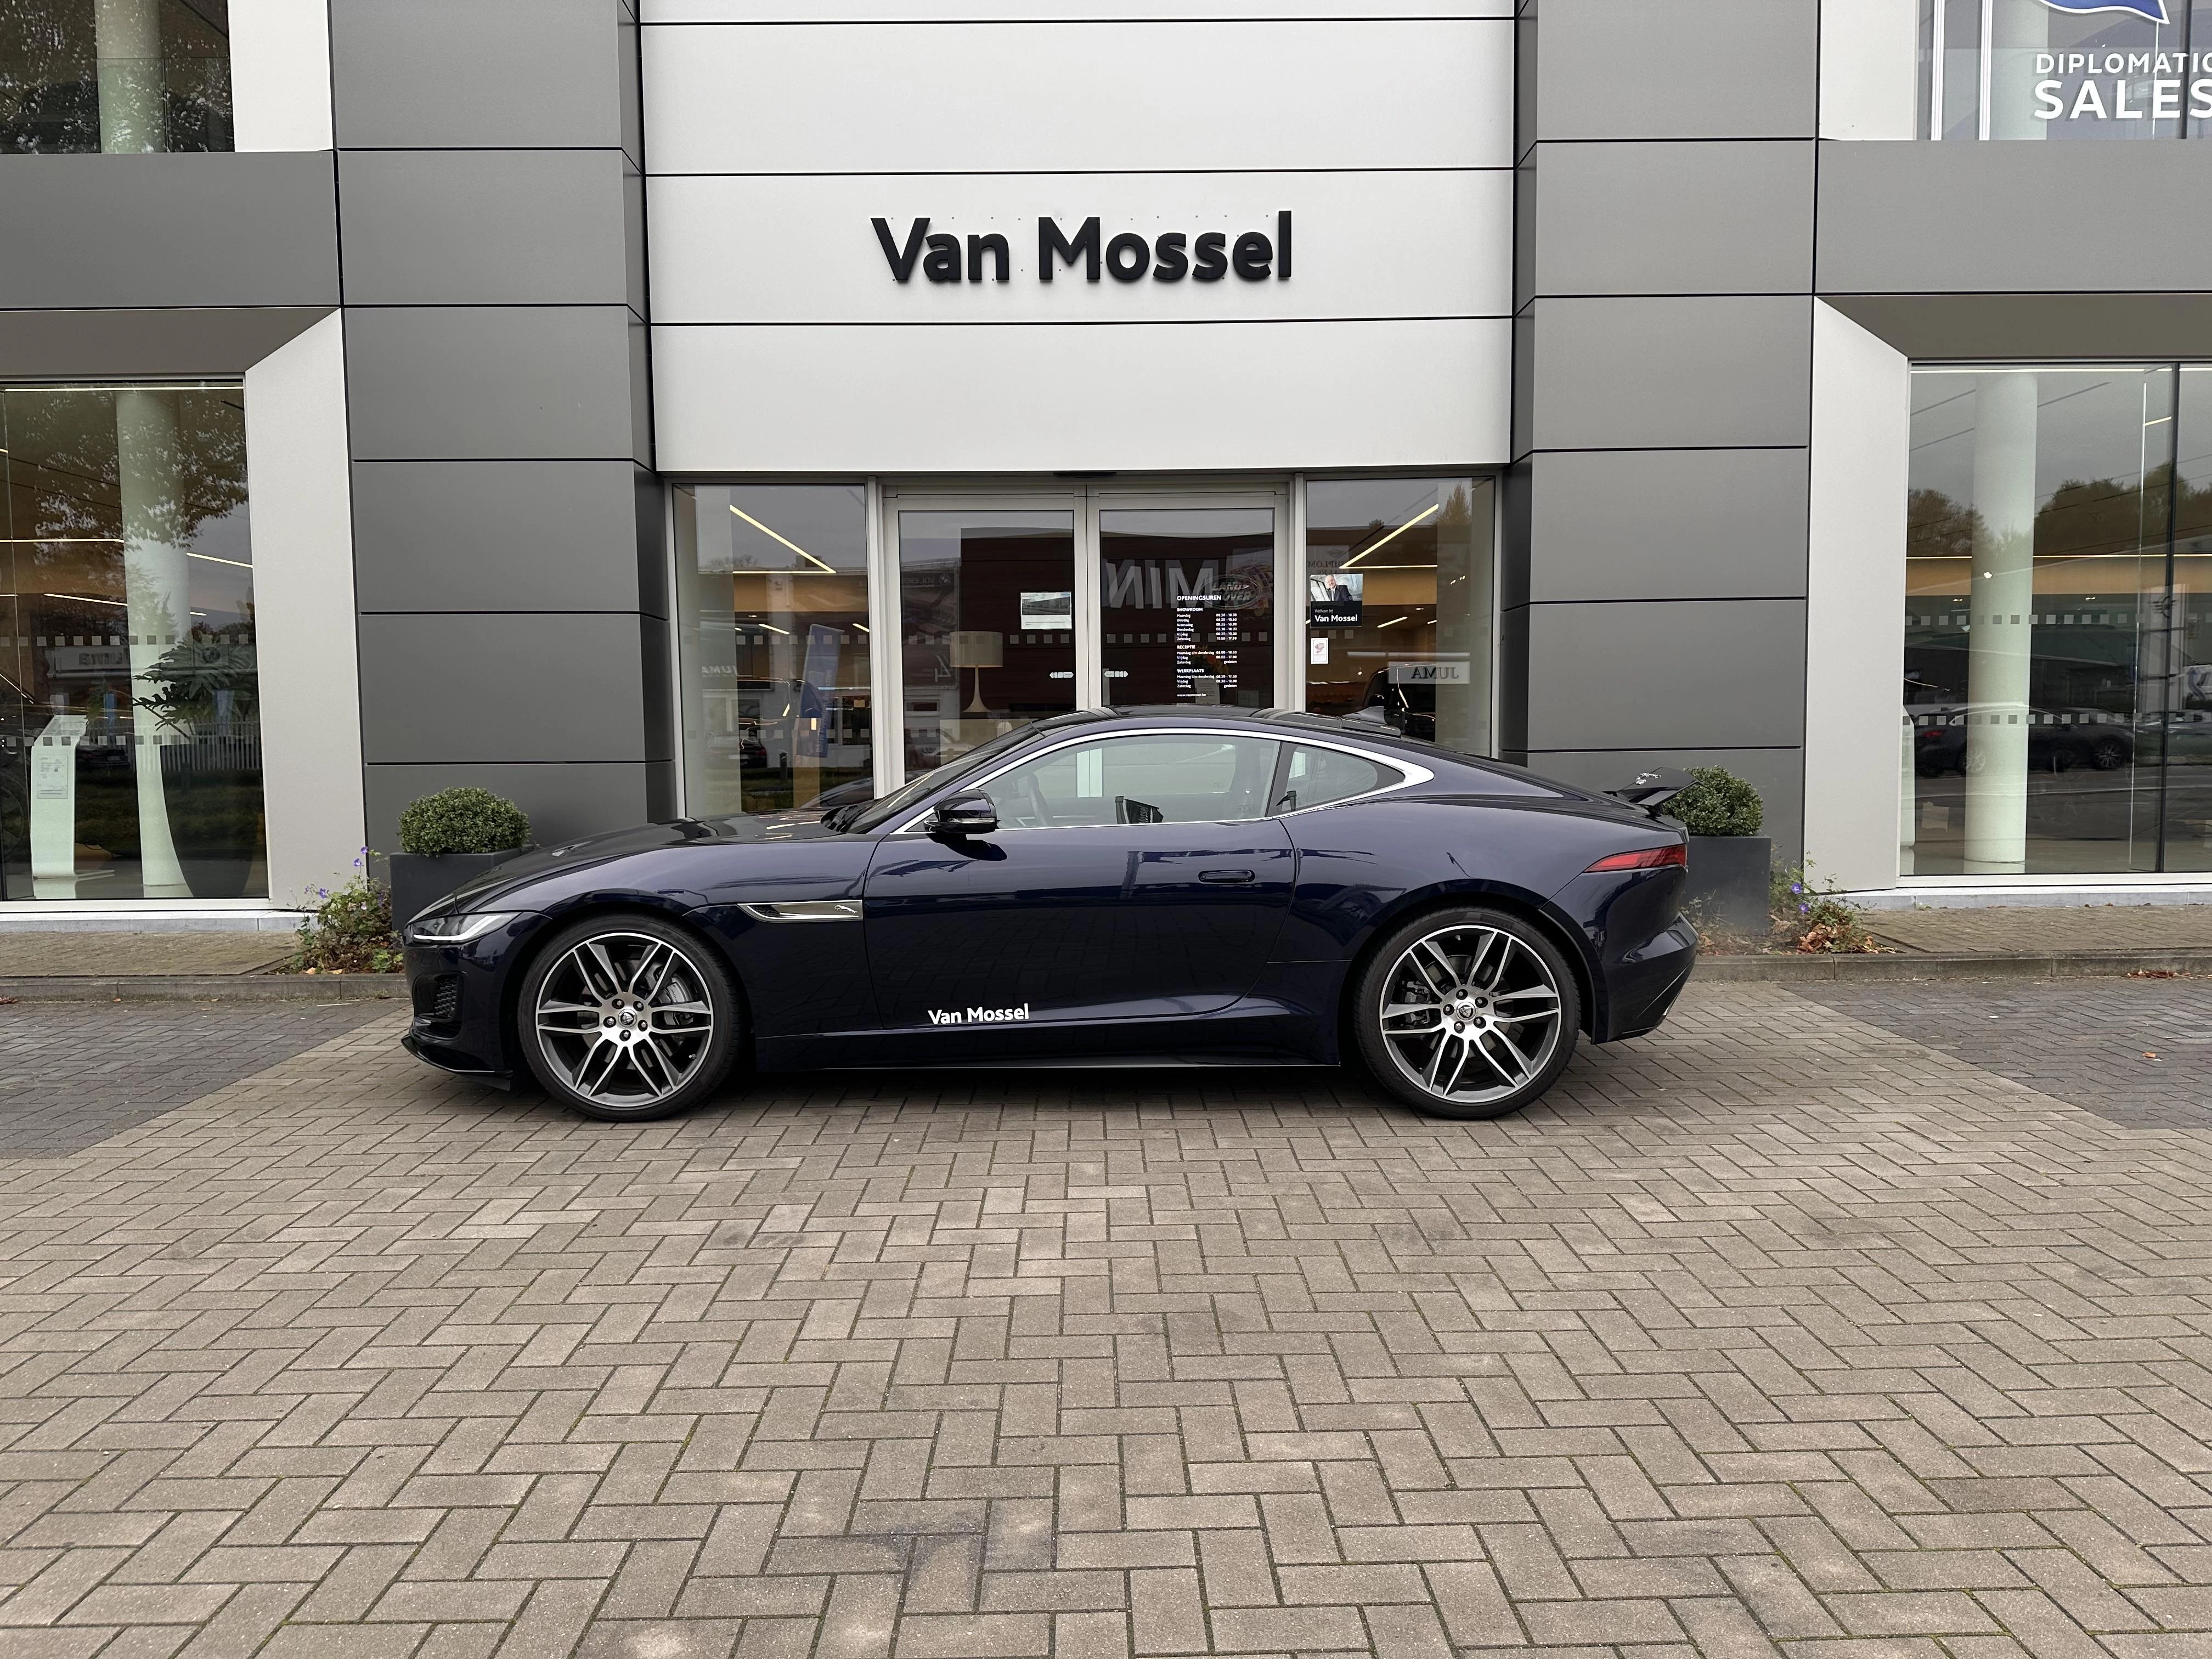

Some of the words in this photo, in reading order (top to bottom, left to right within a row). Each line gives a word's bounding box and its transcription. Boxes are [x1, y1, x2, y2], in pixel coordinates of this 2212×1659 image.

[2034, 80, 2212, 119] SALES
[871, 217, 1009, 282] Van
[1038, 210, 1292, 281] Mossel
[1331, 614, 1358, 622] Mossel
[927, 1009, 962, 1025] Van
[967, 1003, 1029, 1023] Mossel
